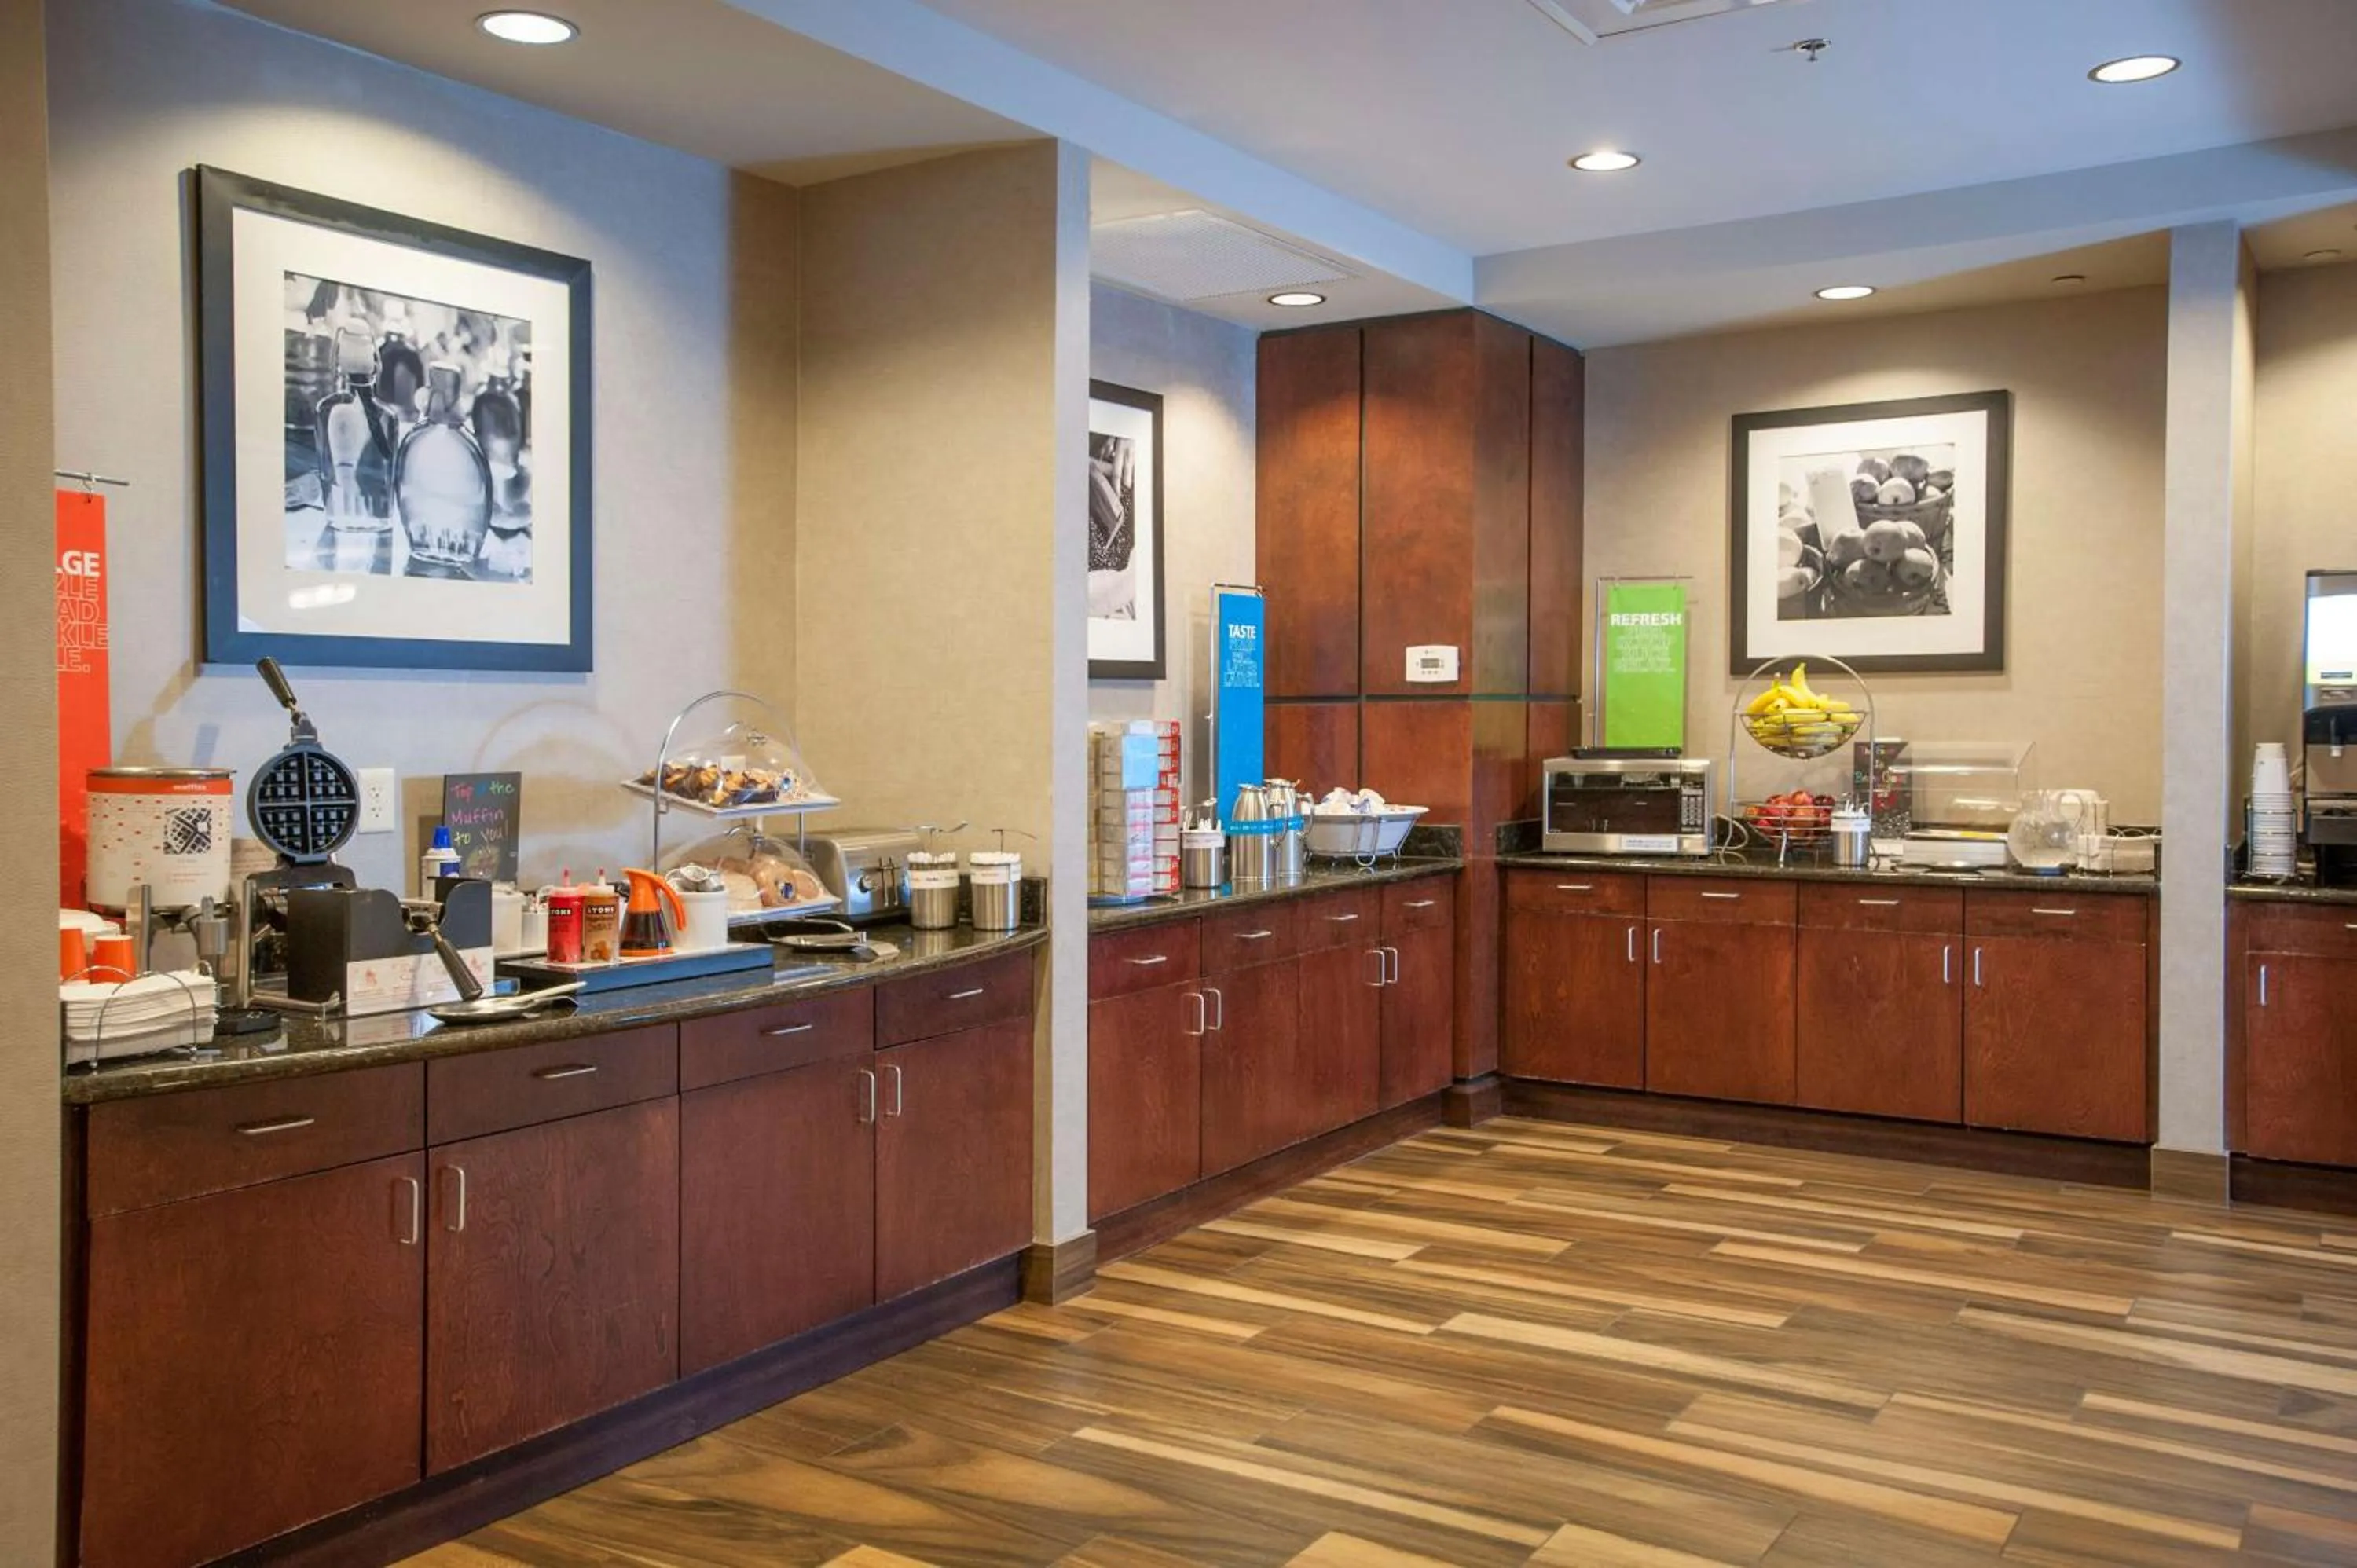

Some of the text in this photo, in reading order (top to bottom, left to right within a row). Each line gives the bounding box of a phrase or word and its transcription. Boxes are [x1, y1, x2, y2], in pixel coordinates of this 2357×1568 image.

[55, 550, 101, 577] GE
[1611, 613, 1681, 626] REFRESH
[1228, 623, 1256, 639] TASTE
